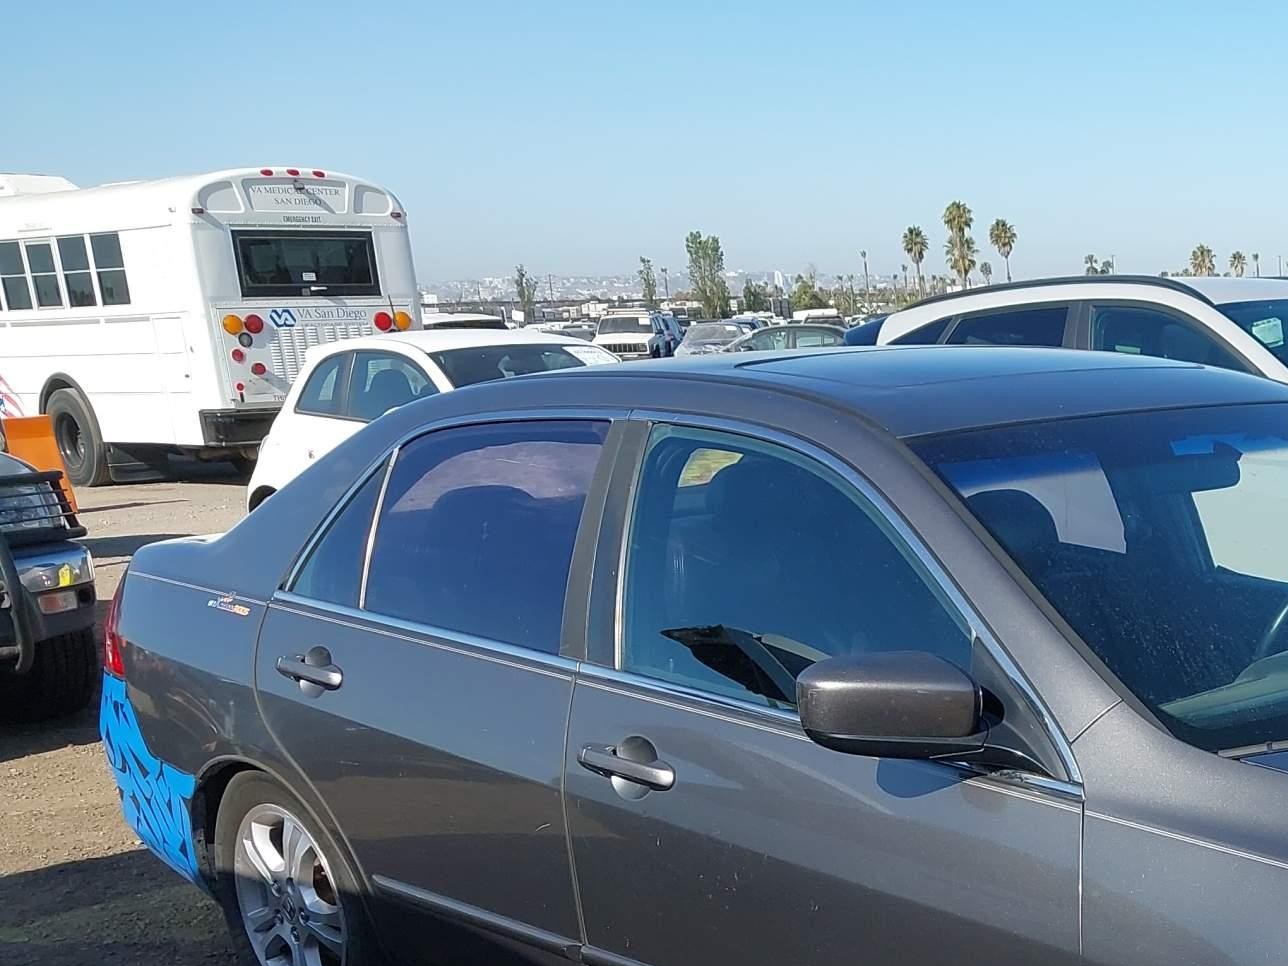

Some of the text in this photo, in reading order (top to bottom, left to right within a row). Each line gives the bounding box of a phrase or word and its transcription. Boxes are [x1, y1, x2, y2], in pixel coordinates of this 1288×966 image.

[252, 186, 264, 194] VA
[306, 188, 340, 196] CENTER
[294, 198, 322, 206] DIEGO
[297, 308, 367, 320] VA San Diego
